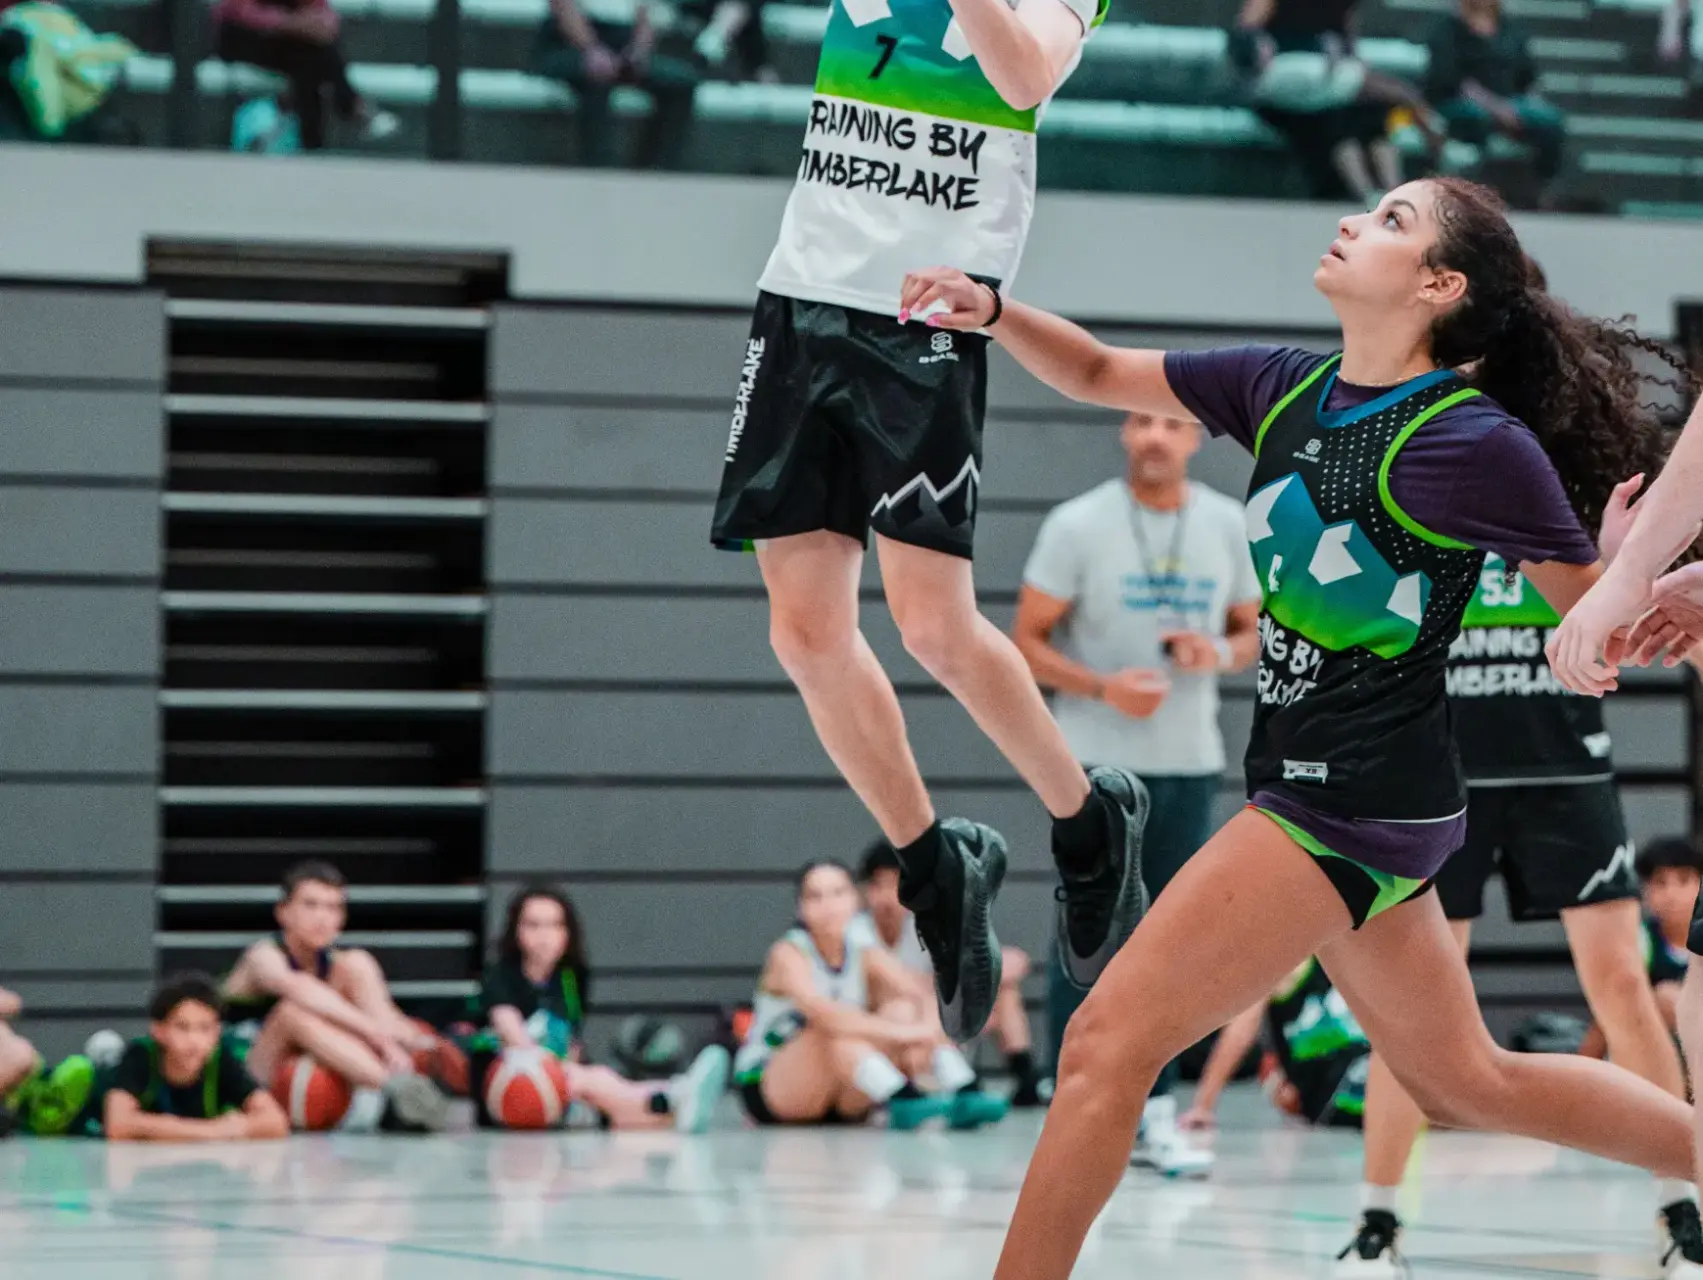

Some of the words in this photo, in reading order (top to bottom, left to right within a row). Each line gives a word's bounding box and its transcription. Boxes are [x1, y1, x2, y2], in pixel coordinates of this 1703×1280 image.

[868, 34, 898, 79] 7
[810, 100, 917, 151] RAINING
[928, 123, 987, 175] BY
